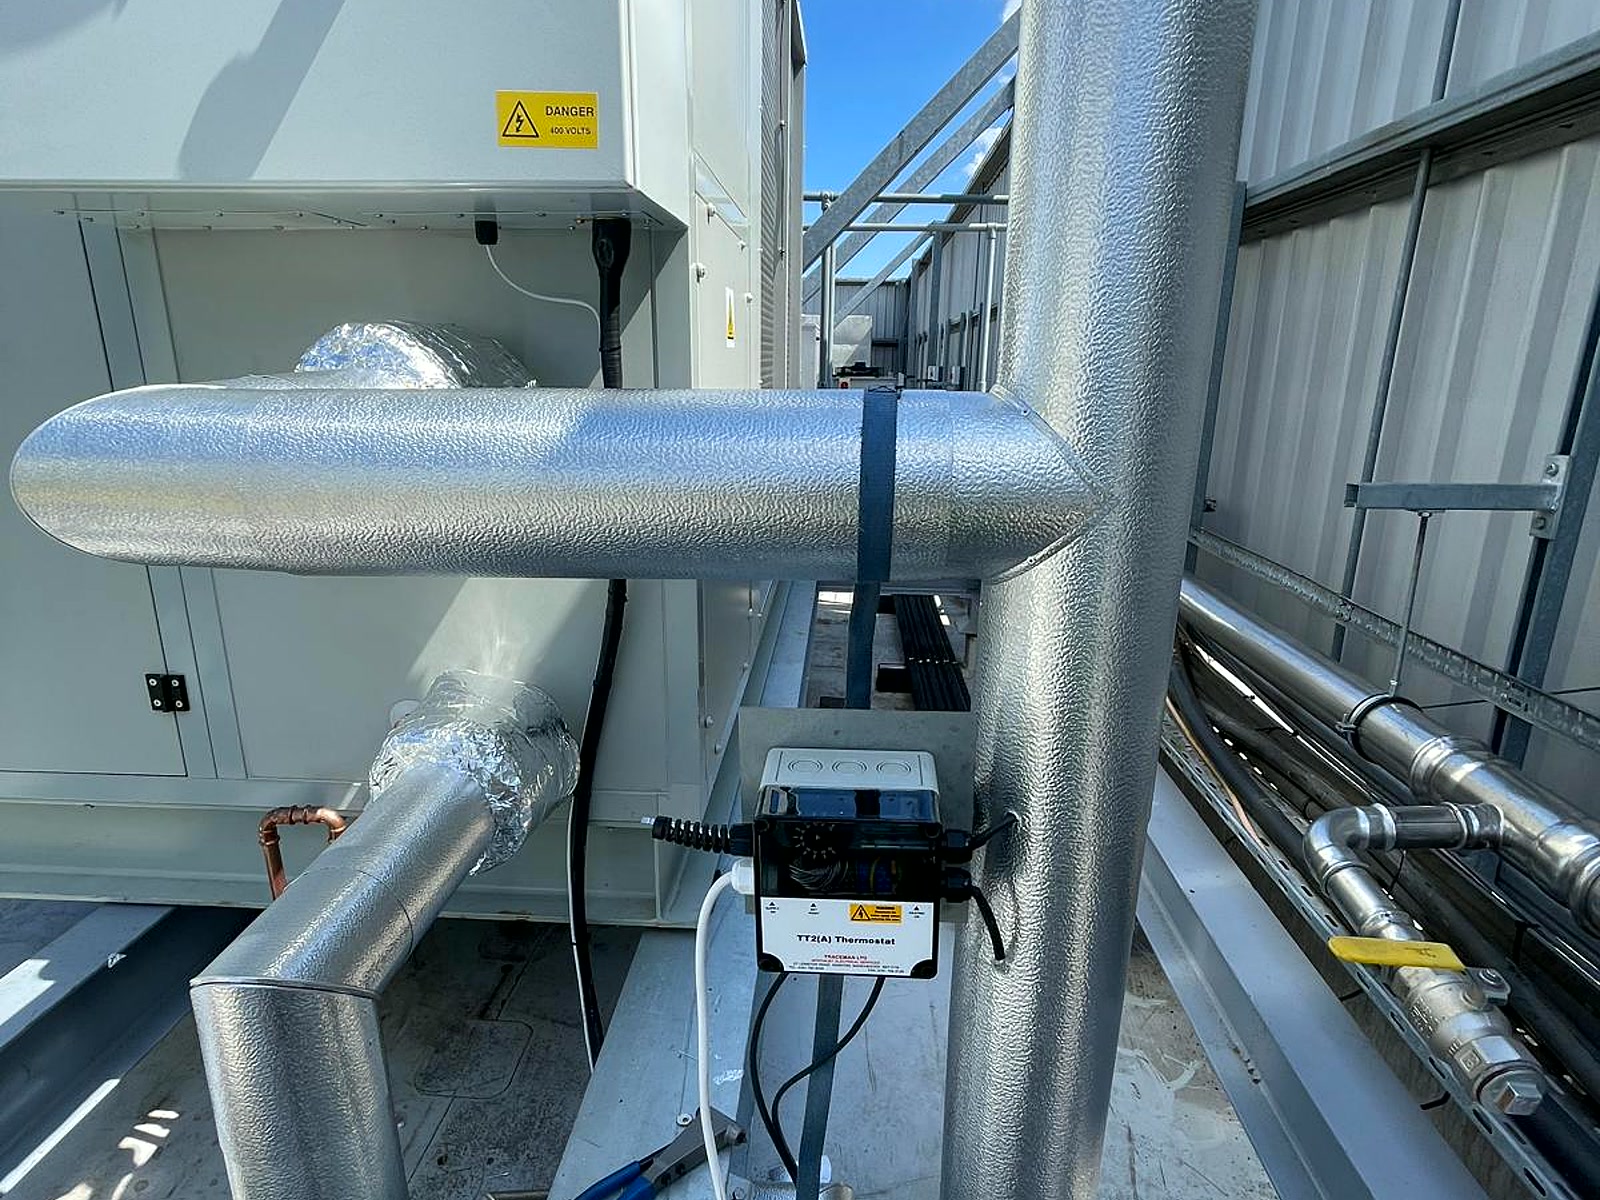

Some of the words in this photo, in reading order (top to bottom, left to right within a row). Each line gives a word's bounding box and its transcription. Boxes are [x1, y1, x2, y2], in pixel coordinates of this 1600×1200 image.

[545, 106, 594, 116] DANGER
[796, 934, 832, 943] TT2(A)
[835, 936, 895, 945] Thermostat
